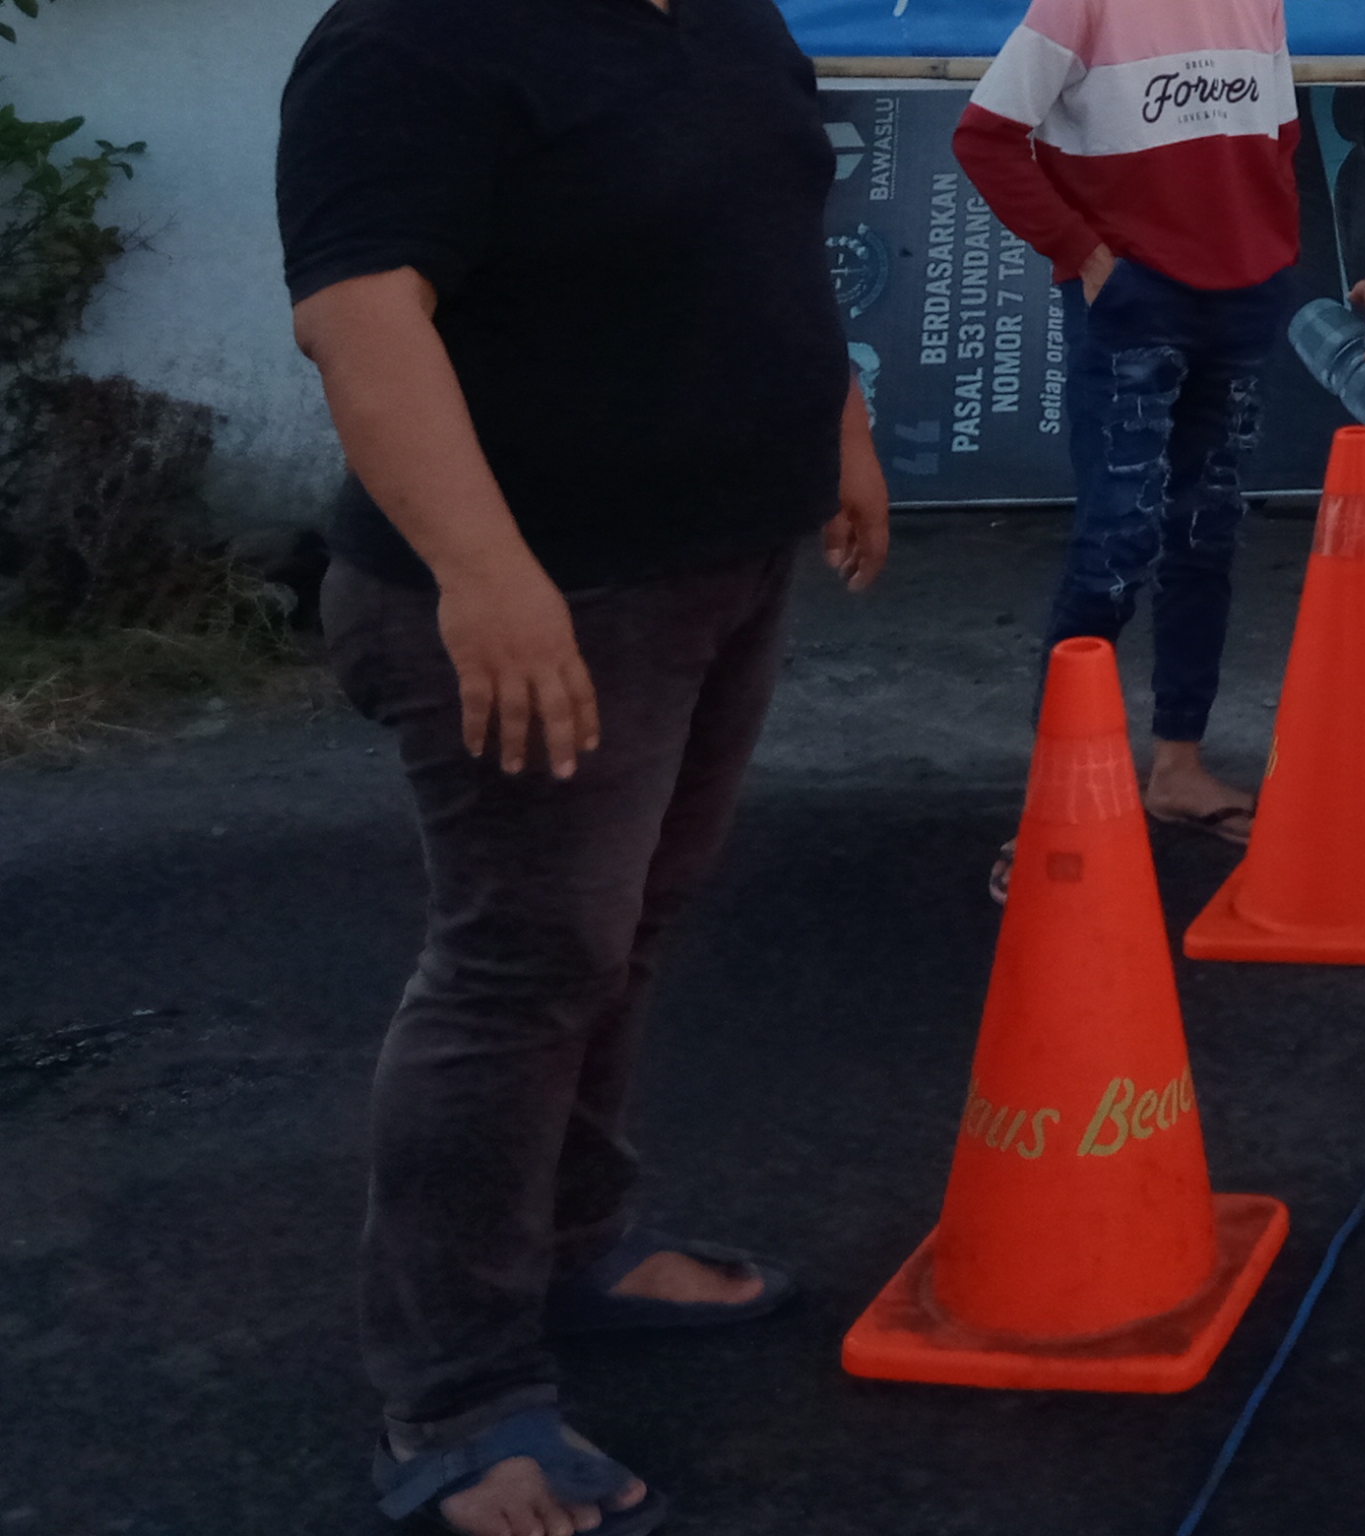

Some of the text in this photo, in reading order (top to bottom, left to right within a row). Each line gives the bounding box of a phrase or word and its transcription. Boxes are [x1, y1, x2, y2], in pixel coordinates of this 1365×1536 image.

[869, 97, 894, 201] BAWASLU
[920, 172, 958, 365] BERDASARKAN
[990, 230, 1028, 413] NOMOR 7 TAH
[1045, 306, 1063, 363] orang
[952, 367, 984, 452] PASAL
[1038, 368, 1066, 434] Setiap
